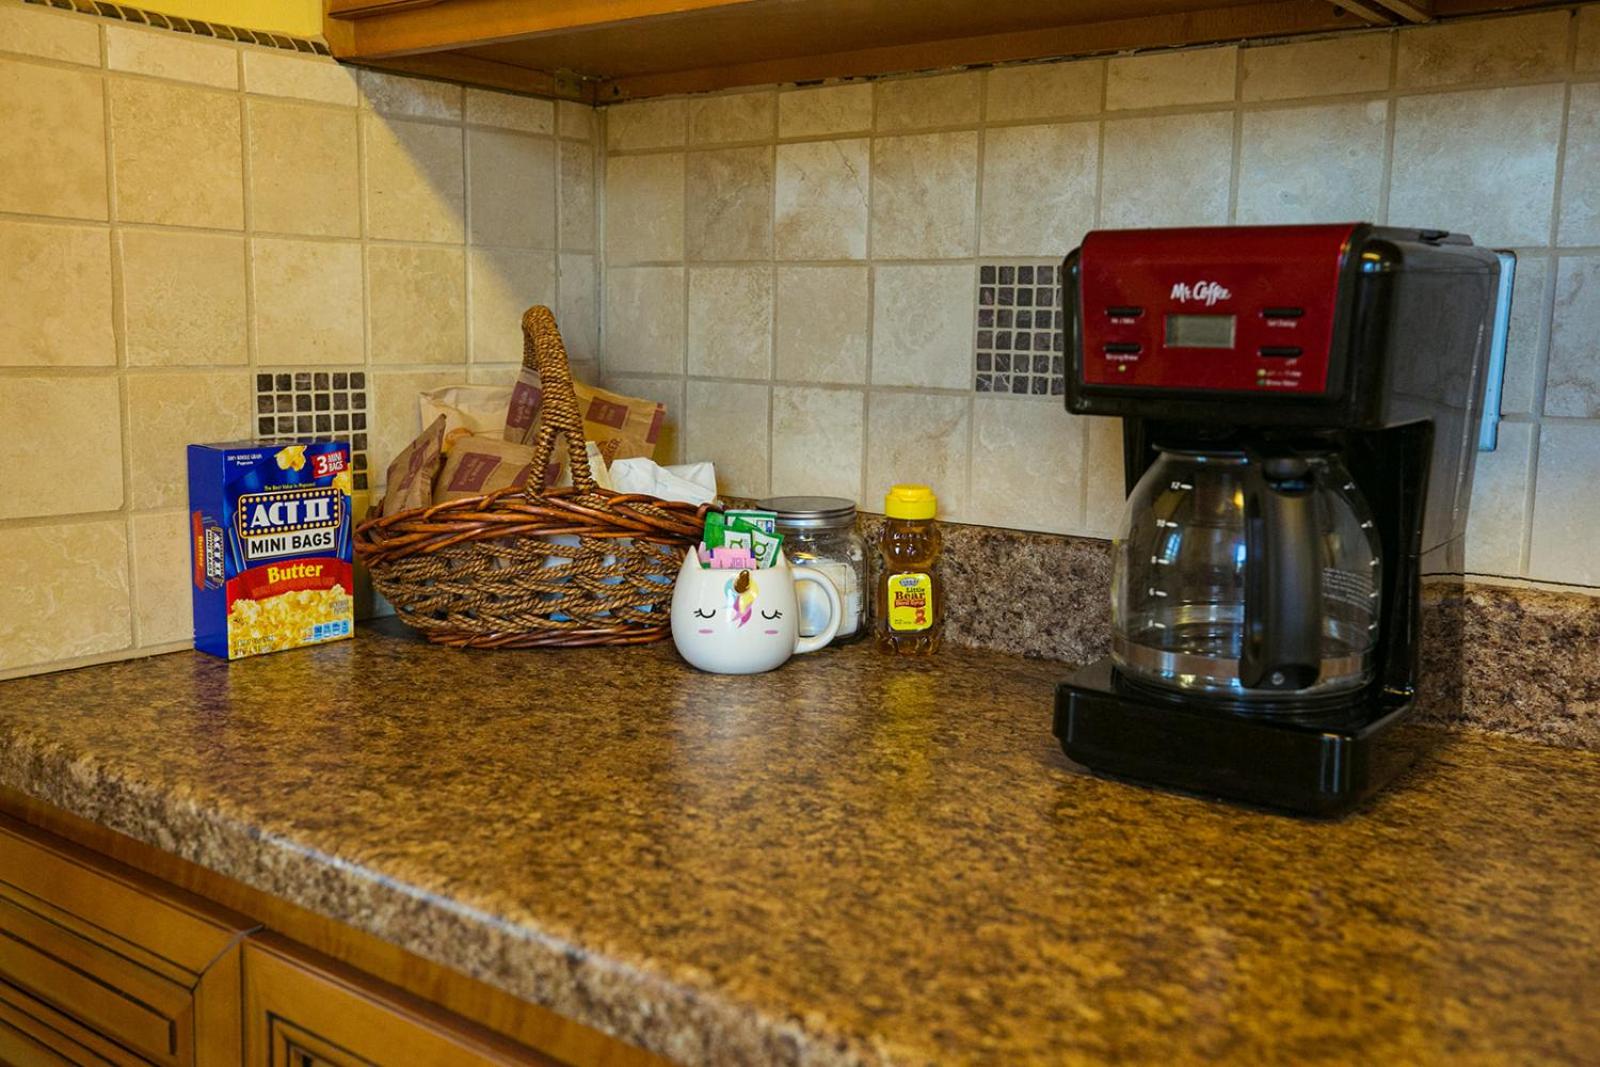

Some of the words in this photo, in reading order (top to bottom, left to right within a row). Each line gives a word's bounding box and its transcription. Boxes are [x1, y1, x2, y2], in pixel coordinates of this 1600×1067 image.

[1193, 280, 1232, 307] Coffee
[316, 455, 328, 474] 3
[328, 452, 342, 463] MINI
[328, 461, 344, 472] BAGS
[1171, 482, 1181, 490] 12
[250, 501, 300, 528] ACT
[303, 498, 330, 523] II
[1156, 518, 1166, 528] 10
[197, 535, 205, 568] Butter
[213, 532, 221, 559] ACT
[251, 537, 286, 555] MINI
[291, 532, 332, 550] BAGS
[267, 563, 324, 585] Butter
[894, 591, 925, 600] Bear
